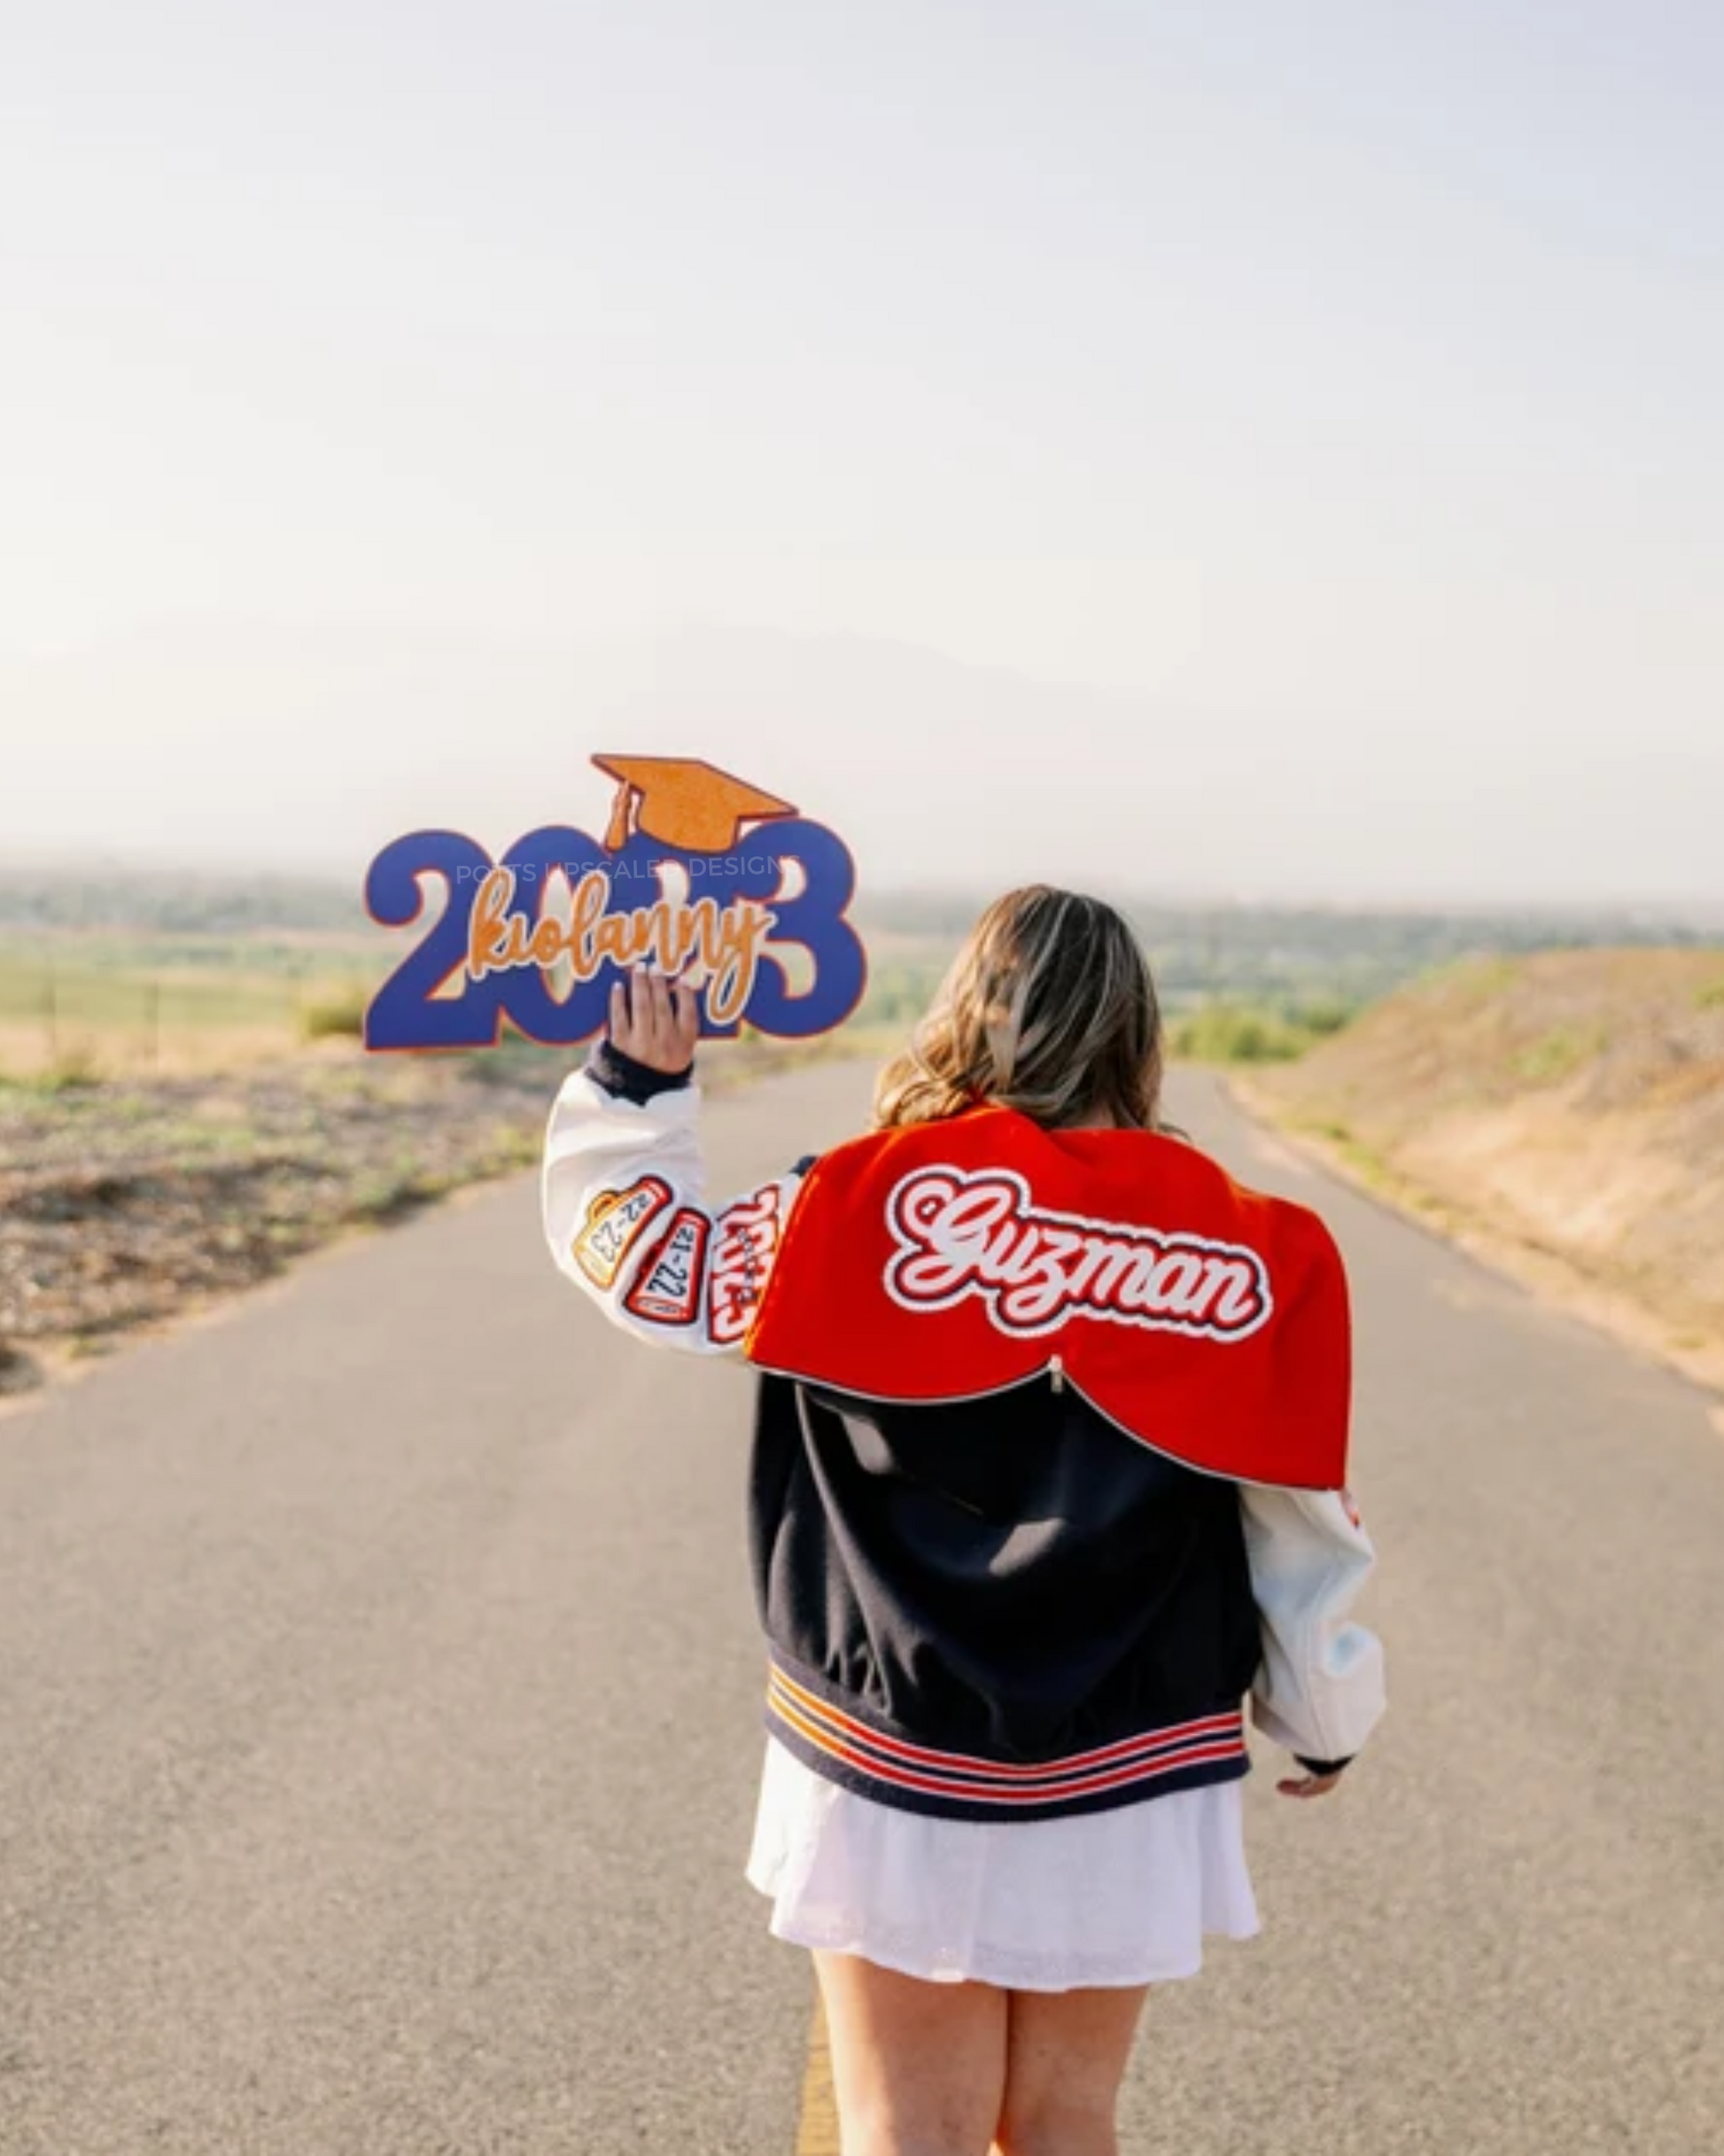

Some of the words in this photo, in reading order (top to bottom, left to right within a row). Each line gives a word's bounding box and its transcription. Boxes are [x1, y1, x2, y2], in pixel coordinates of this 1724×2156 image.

[364, 818, 867, 1050] 2023
[589, 1192, 649, 1264] 22-23
[645, 1226, 696, 1298] 21-22
[897, 1175, 1258, 1325] Guzman
